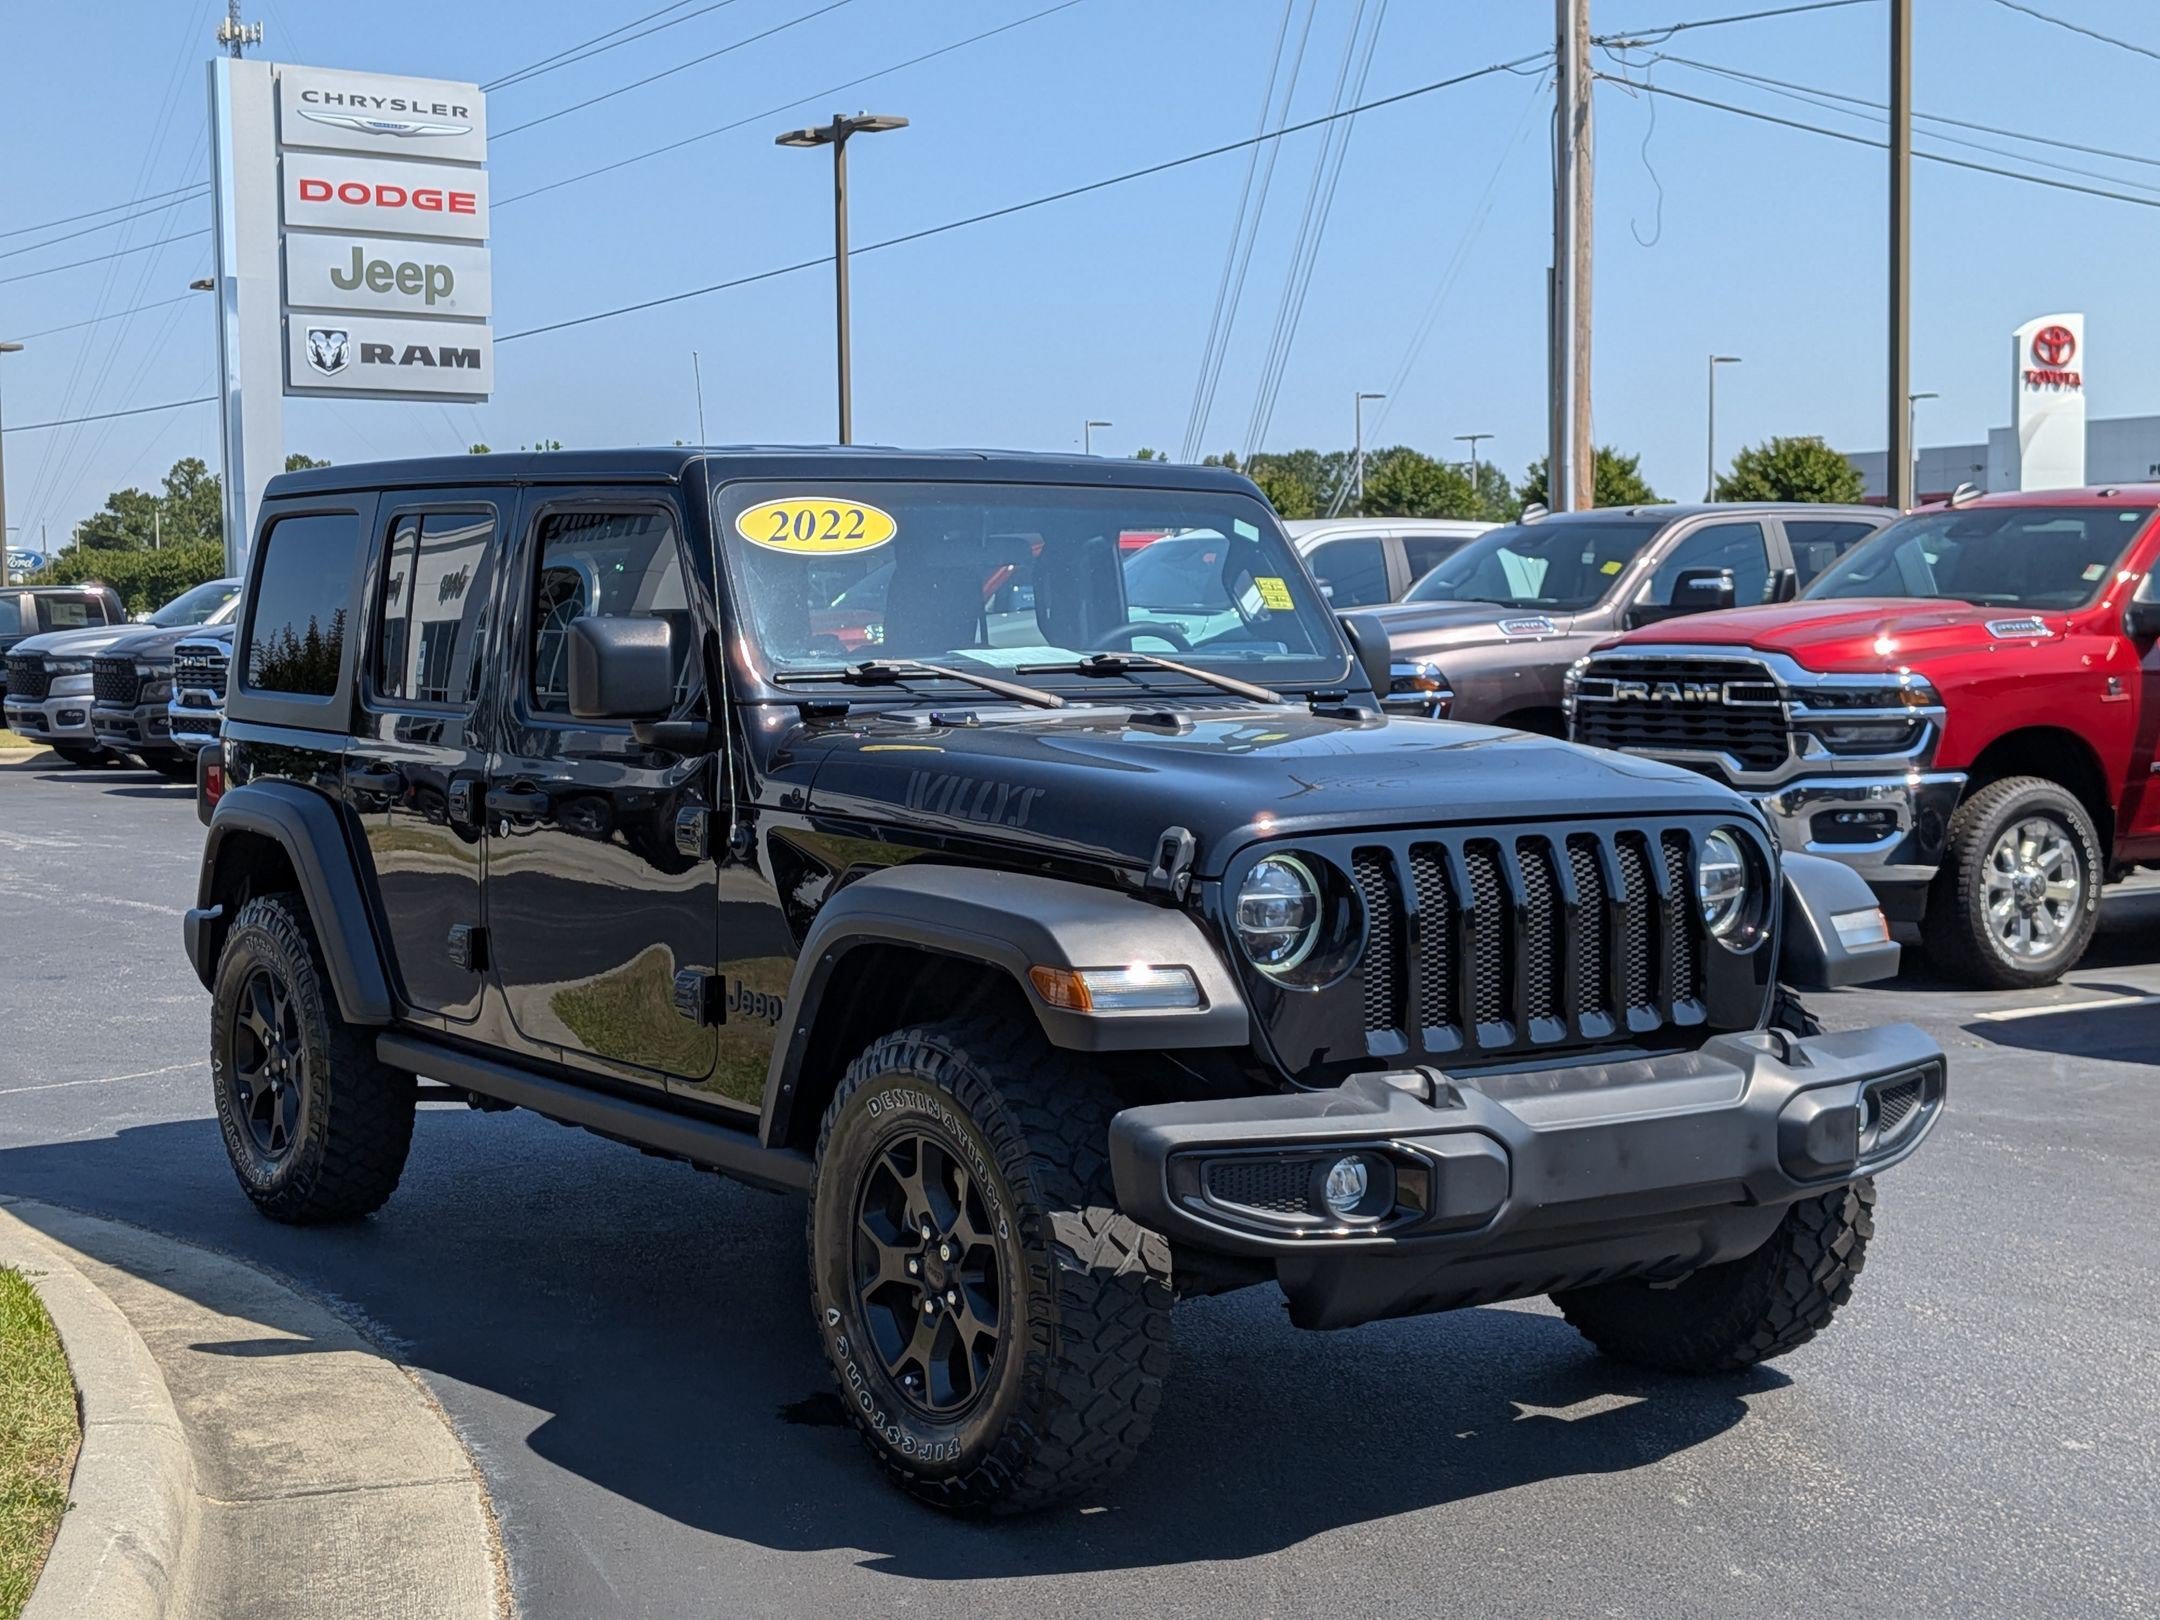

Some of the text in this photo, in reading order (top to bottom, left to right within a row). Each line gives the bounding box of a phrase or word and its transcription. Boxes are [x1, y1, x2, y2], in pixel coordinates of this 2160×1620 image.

[300, 90, 469, 119] CHRYSLER
[299, 178, 477, 214] DODGE
[330, 246, 455, 305] Jeep
[360, 342, 481, 369] RAM
[2022, 370, 2081, 386] TOYOTA
[767, 509, 866, 542] 2022
[1617, 681, 1719, 702] RAM
[905, 770, 1046, 827] WILLYS
[727, 980, 783, 1027] Jeep
[866, 1088, 1000, 1211] DESTINATION
